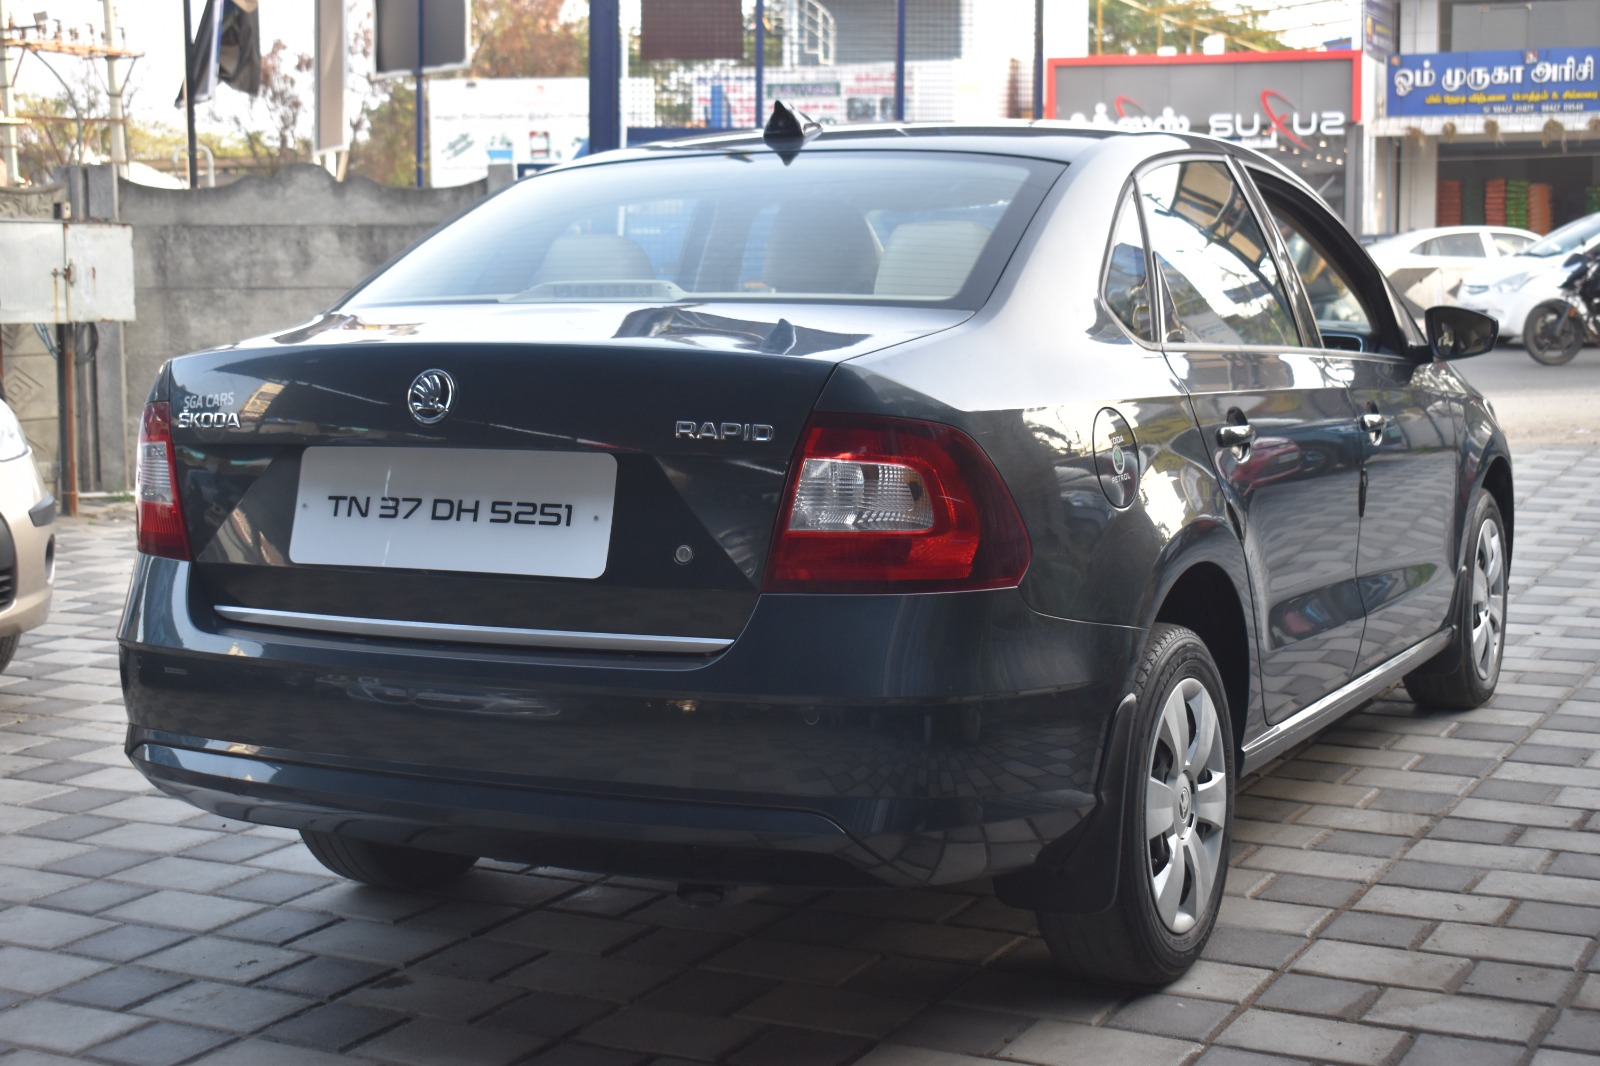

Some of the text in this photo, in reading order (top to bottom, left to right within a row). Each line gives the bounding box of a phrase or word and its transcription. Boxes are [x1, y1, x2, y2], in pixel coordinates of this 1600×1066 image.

[1394, 55, 1594, 96] ஓம் முருகா அரிசி
[183, 392, 234, 410] SGA CARS
[178, 409, 240, 428] ŠKODA
[675, 420, 774, 441] RAPID
[1111, 472, 1131, 484] PETROL
[328, 496, 573, 527] TN 37 DH 5251
